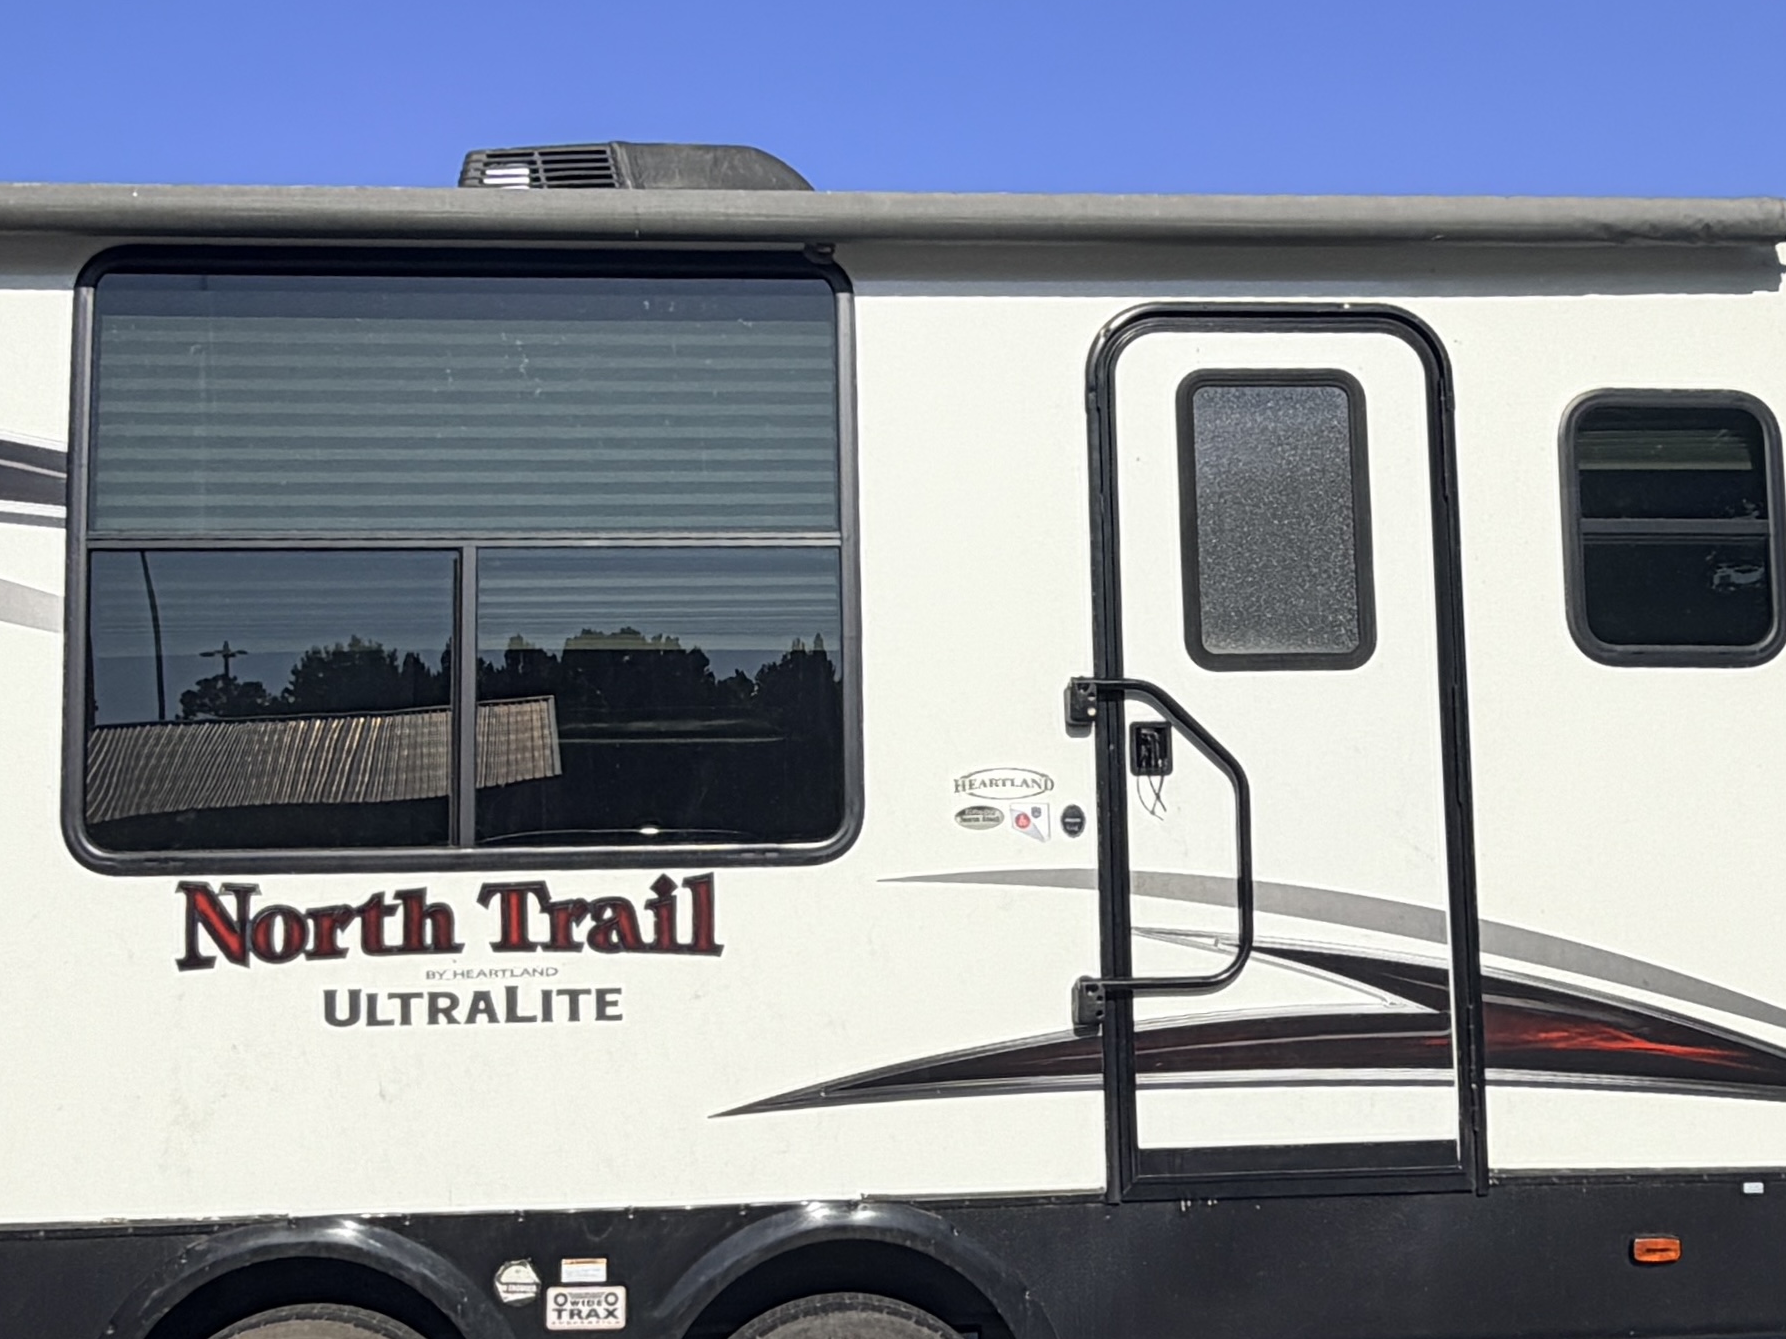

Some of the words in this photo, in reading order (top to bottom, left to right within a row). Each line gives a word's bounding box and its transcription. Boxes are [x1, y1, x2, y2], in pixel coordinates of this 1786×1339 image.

[953, 776, 1055, 793] HEARTLAND
[175, 879, 465, 972] North
[476, 871, 724, 958] Trail
[425, 969, 447, 980] BY
[452, 966, 559, 980] HEARTLAND
[570, 1299, 603, 1307] WIDE
[552, 1308, 619, 1320] TRAX
